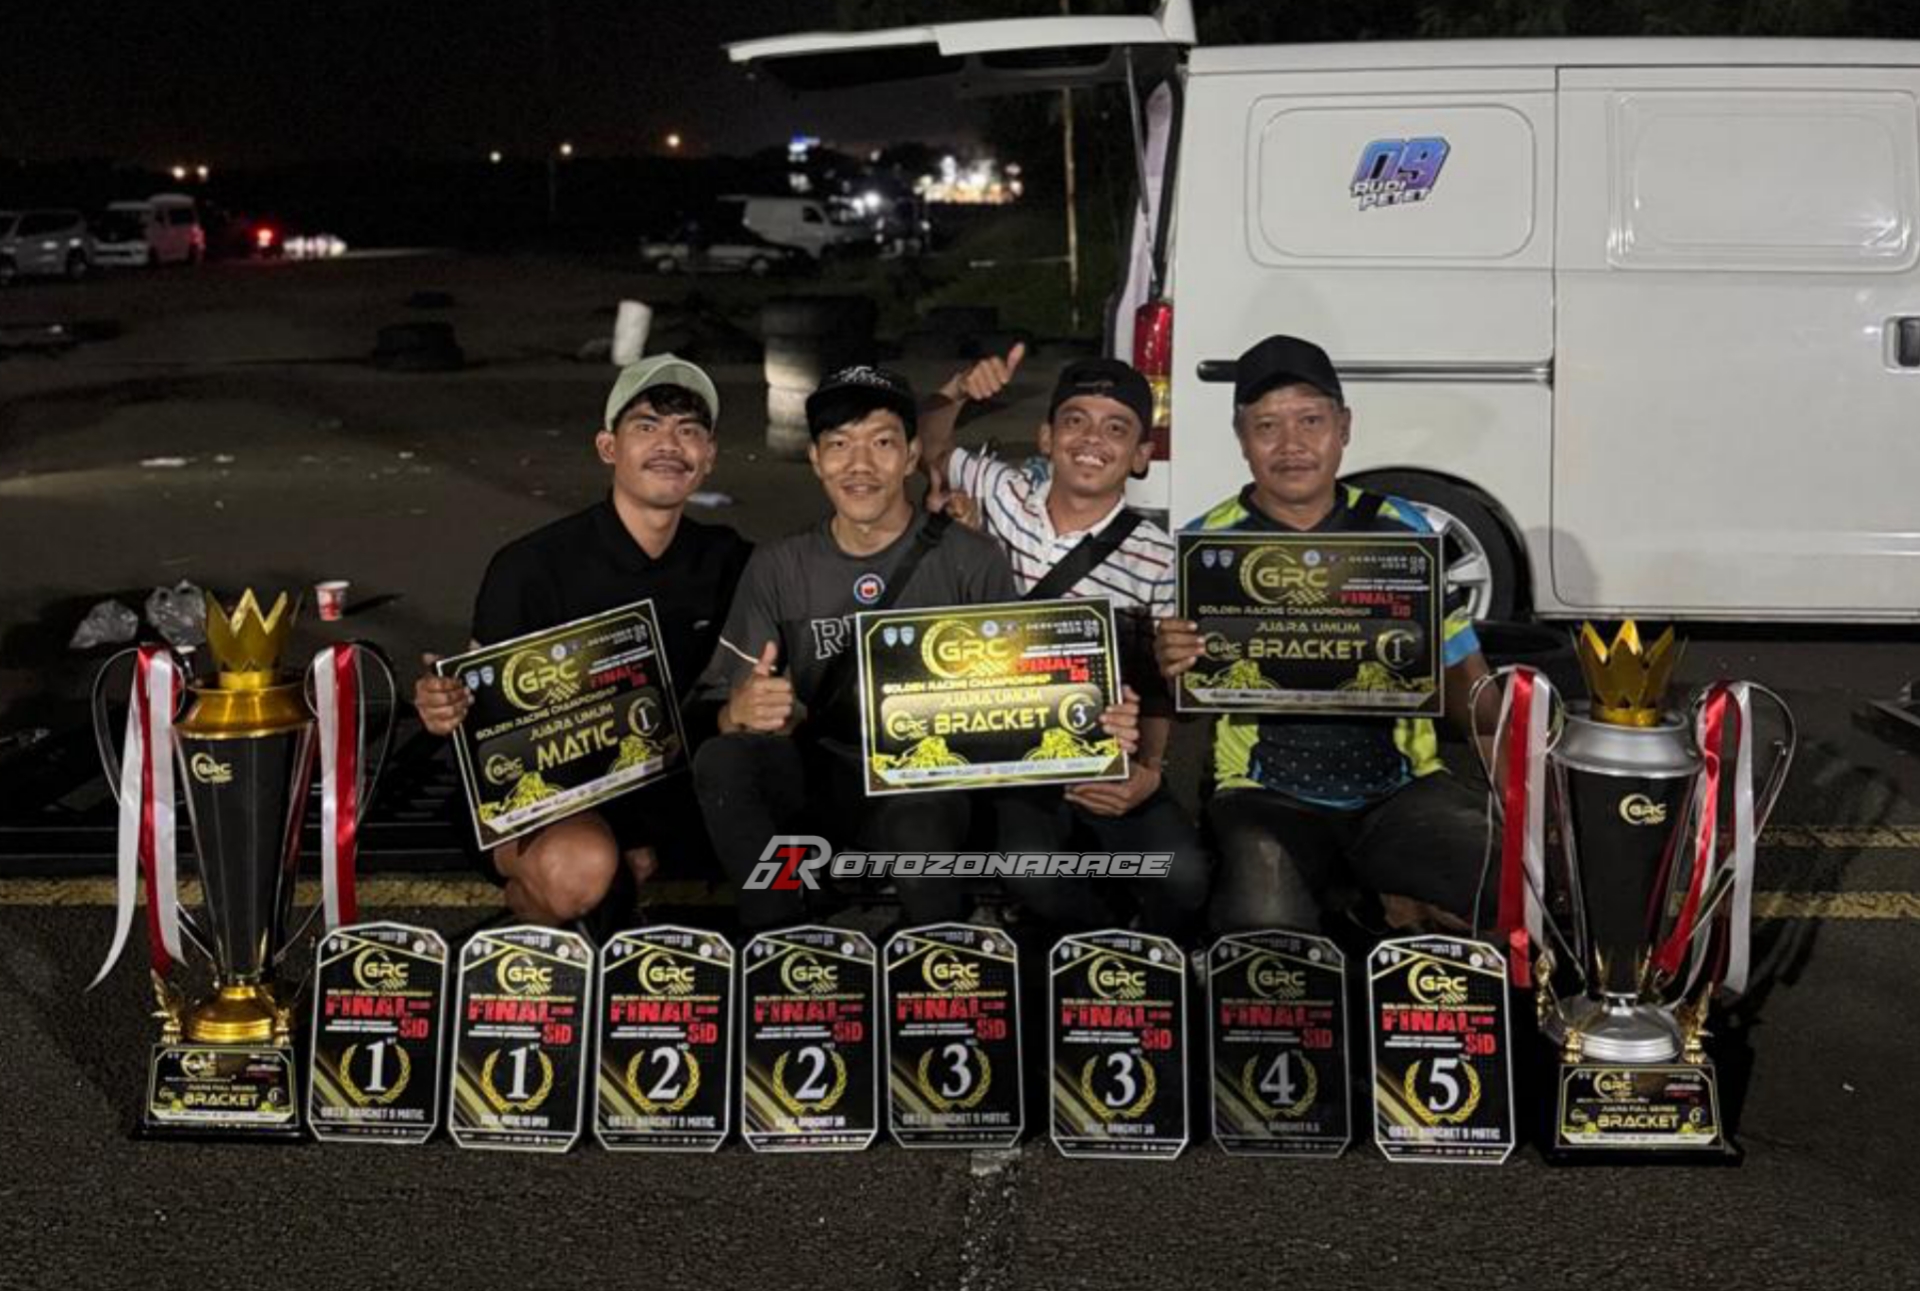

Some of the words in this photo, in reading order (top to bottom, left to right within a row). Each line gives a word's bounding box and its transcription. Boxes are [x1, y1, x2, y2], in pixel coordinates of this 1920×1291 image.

[1256, 566, 1329, 588] GRC
[1256, 622, 1309, 633] JUARA
[1312, 622, 1361, 634] UMUM
[938, 638, 1008, 661] GRC
[1248, 638, 1367, 660] BRACKET
[517, 657, 580, 694] GRC
[530, 719, 573, 741] JUARA
[574, 703, 614, 725] UMUM
[934, 707, 1050, 735] BRACKET
[1071, 703, 1088, 728] 3
[536, 720, 619, 771] MATIC
[364, 962, 409, 978] GRC
[507, 967, 553, 982] GRC
[650, 966, 695, 982] GRC
[792, 966, 838, 982] GRC
[934, 962, 980, 979] GRC
[1099, 970, 1146, 987] GRC
[1419, 976, 1468, 993] GRC
[325, 996, 412, 1016] FINAL
[468, 1001, 555, 1022] FINAL
[611, 1001, 701, 1022] FINAL
[755, 1001, 846, 1022] FINAL
[897, 997, 987, 1020] FINAL
[1062, 1006, 1153, 1028] FINAL
[1382, 1010, 1476, 1032] FINAL
[365, 1041, 387, 1092] 1
[508, 1047, 530, 1099] 1
[647, 1046, 681, 1100] 2
[794, 1046, 828, 1100] 2
[941, 1043, 972, 1098] 3
[1105, 1052, 1136, 1107] 3
[1429, 1056, 1460, 1111] 5
[183, 1092, 259, 1107] BRACKET
[1597, 1114, 1680, 1128] BRACKET
